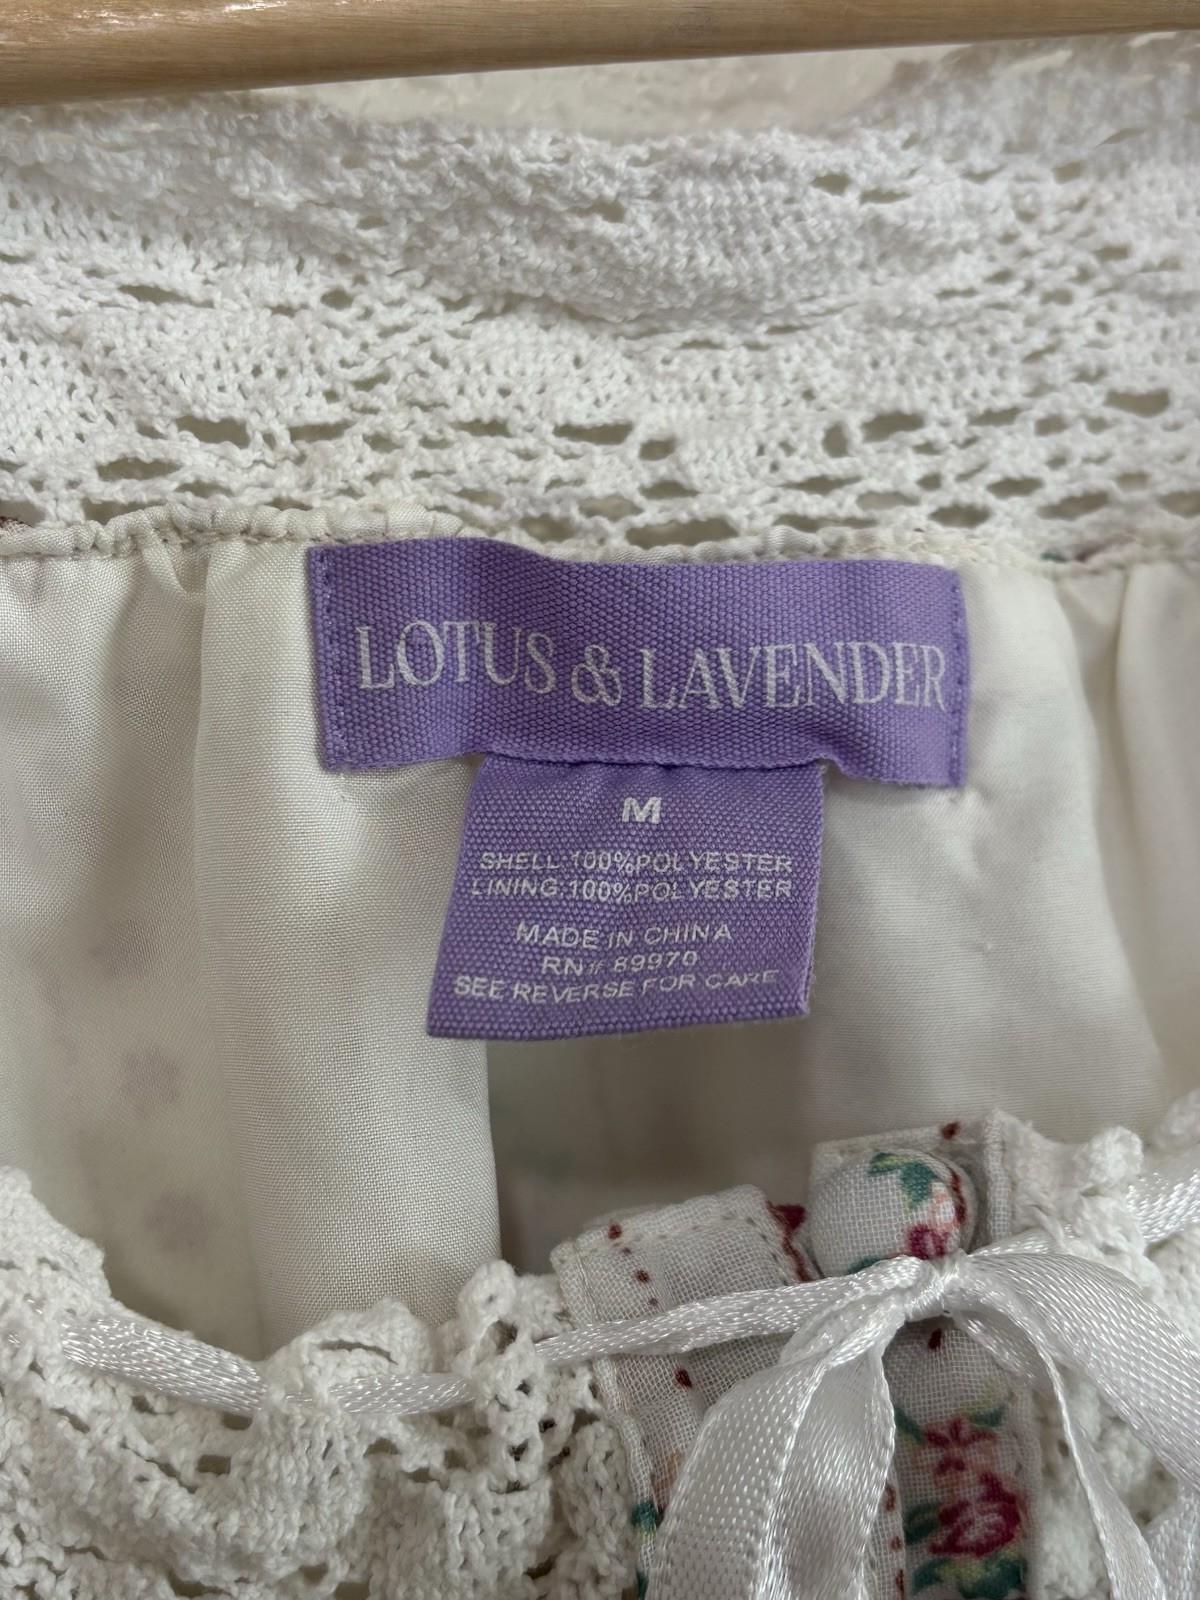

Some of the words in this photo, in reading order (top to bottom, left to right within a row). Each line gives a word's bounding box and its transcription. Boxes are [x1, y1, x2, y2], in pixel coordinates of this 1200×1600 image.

[354, 619, 557, 693] LOTUS
[571, 644, 623, 707] &
[639, 639, 947, 712] LAVENDER
[621, 797, 661, 824] M
[516, 922, 599, 950] MADE
[608, 927, 634, 948] IN
[644, 923, 732, 945] CHINA
[454, 975, 505, 998] SEE
[513, 981, 634, 1004] REVERSE
[642, 973, 696, 996] FOR
[704, 969, 779, 989] CARE
